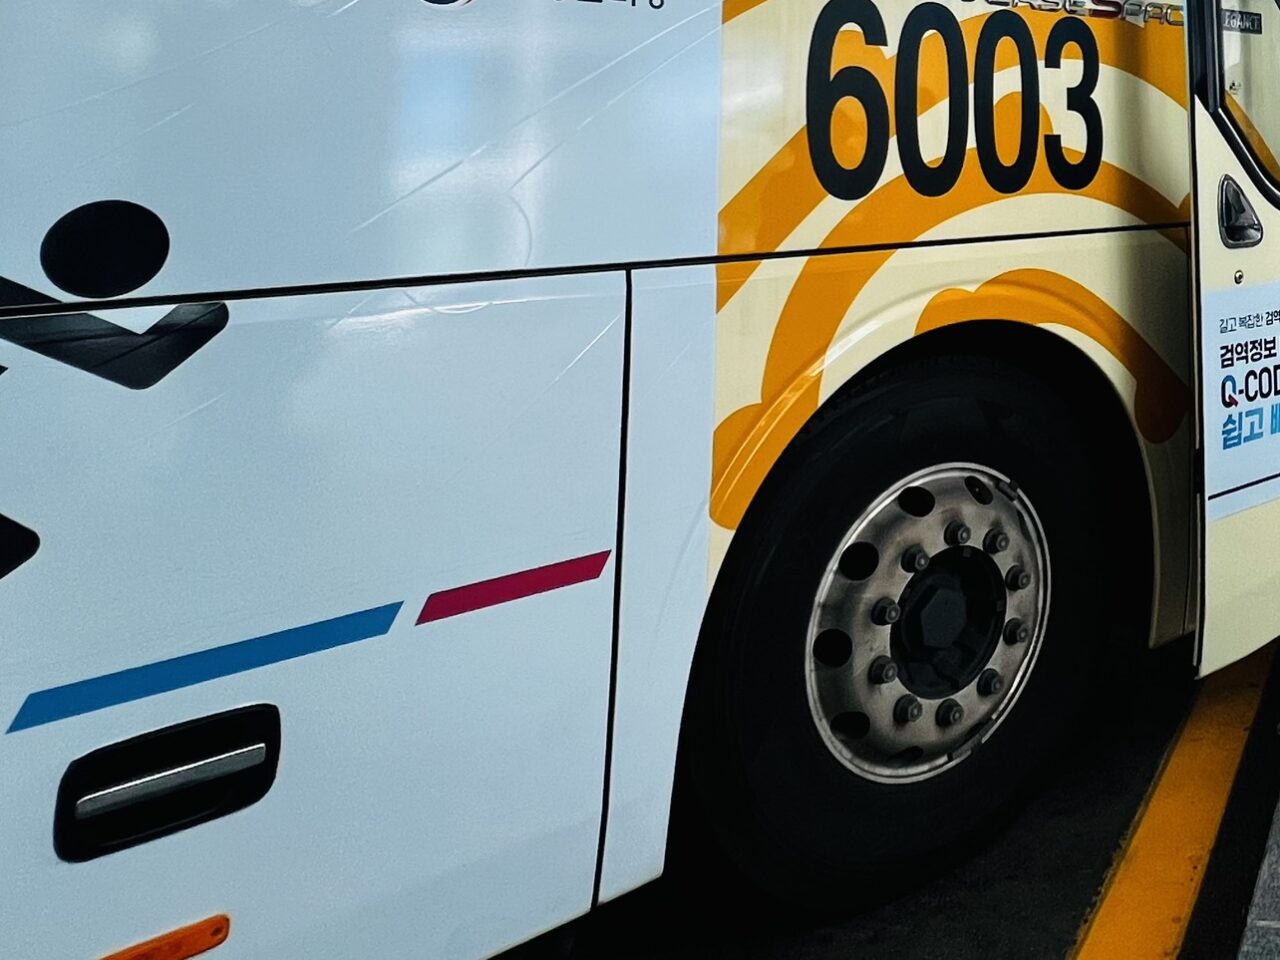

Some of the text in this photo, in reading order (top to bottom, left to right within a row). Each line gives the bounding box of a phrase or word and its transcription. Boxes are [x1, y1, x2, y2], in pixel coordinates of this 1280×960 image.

[1219, 317, 1237, 334] 길고
[1219, 336, 1277, 369] 검역정보
[1222, 406, 1264, 450] 쉽고
